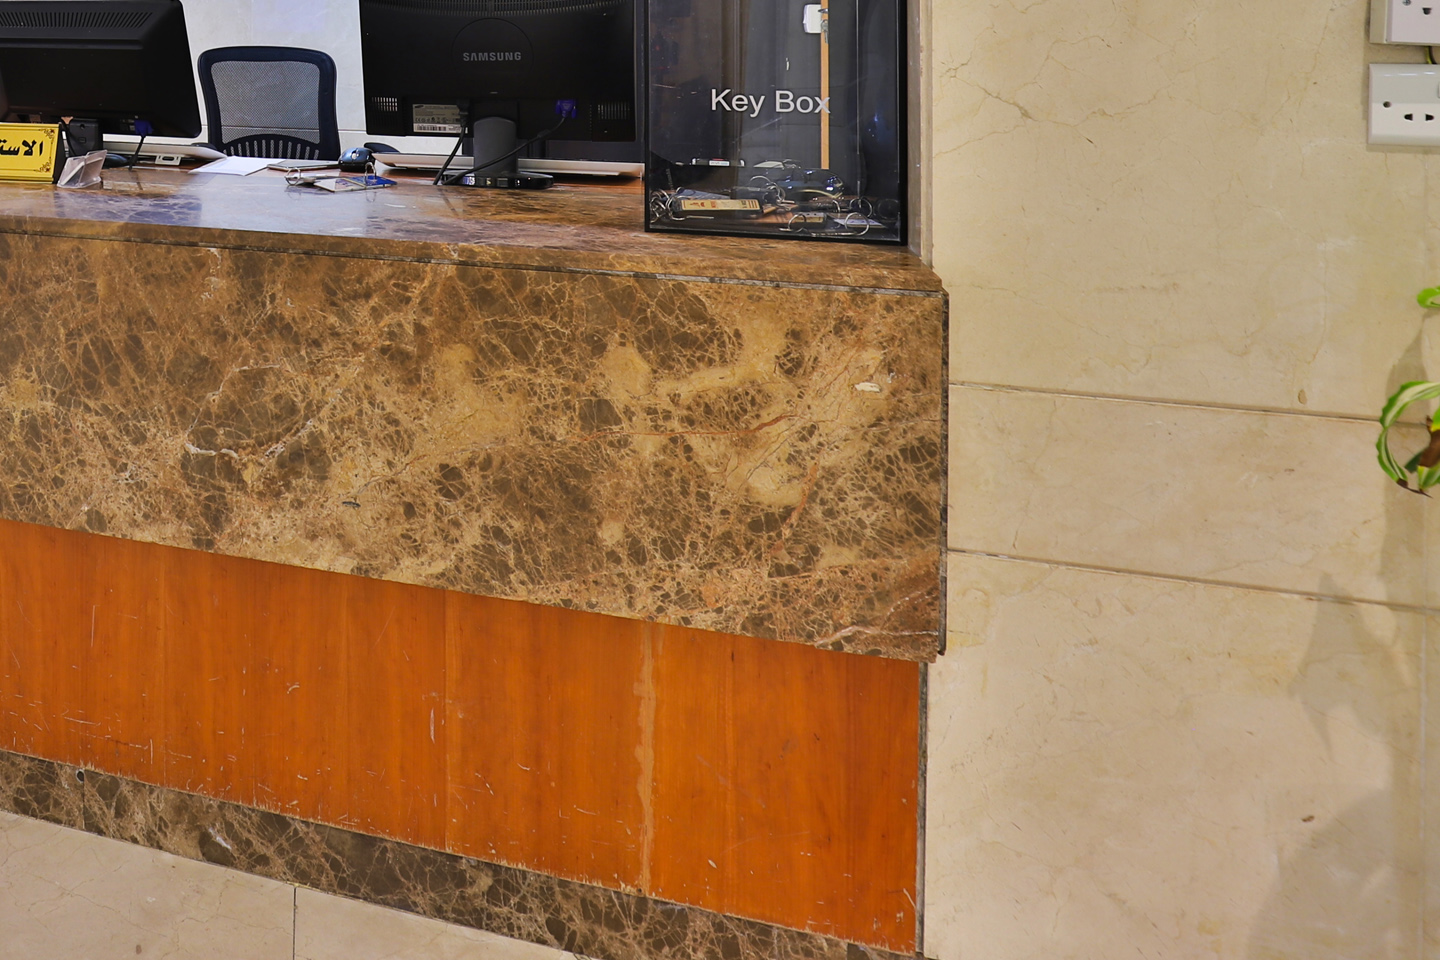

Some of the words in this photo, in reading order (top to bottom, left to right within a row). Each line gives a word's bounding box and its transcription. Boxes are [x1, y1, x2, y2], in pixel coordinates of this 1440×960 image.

[463, 51, 522, 61] SAMSUNG
[711, 89, 765, 118] Key
[775, 90, 831, 114] Box
